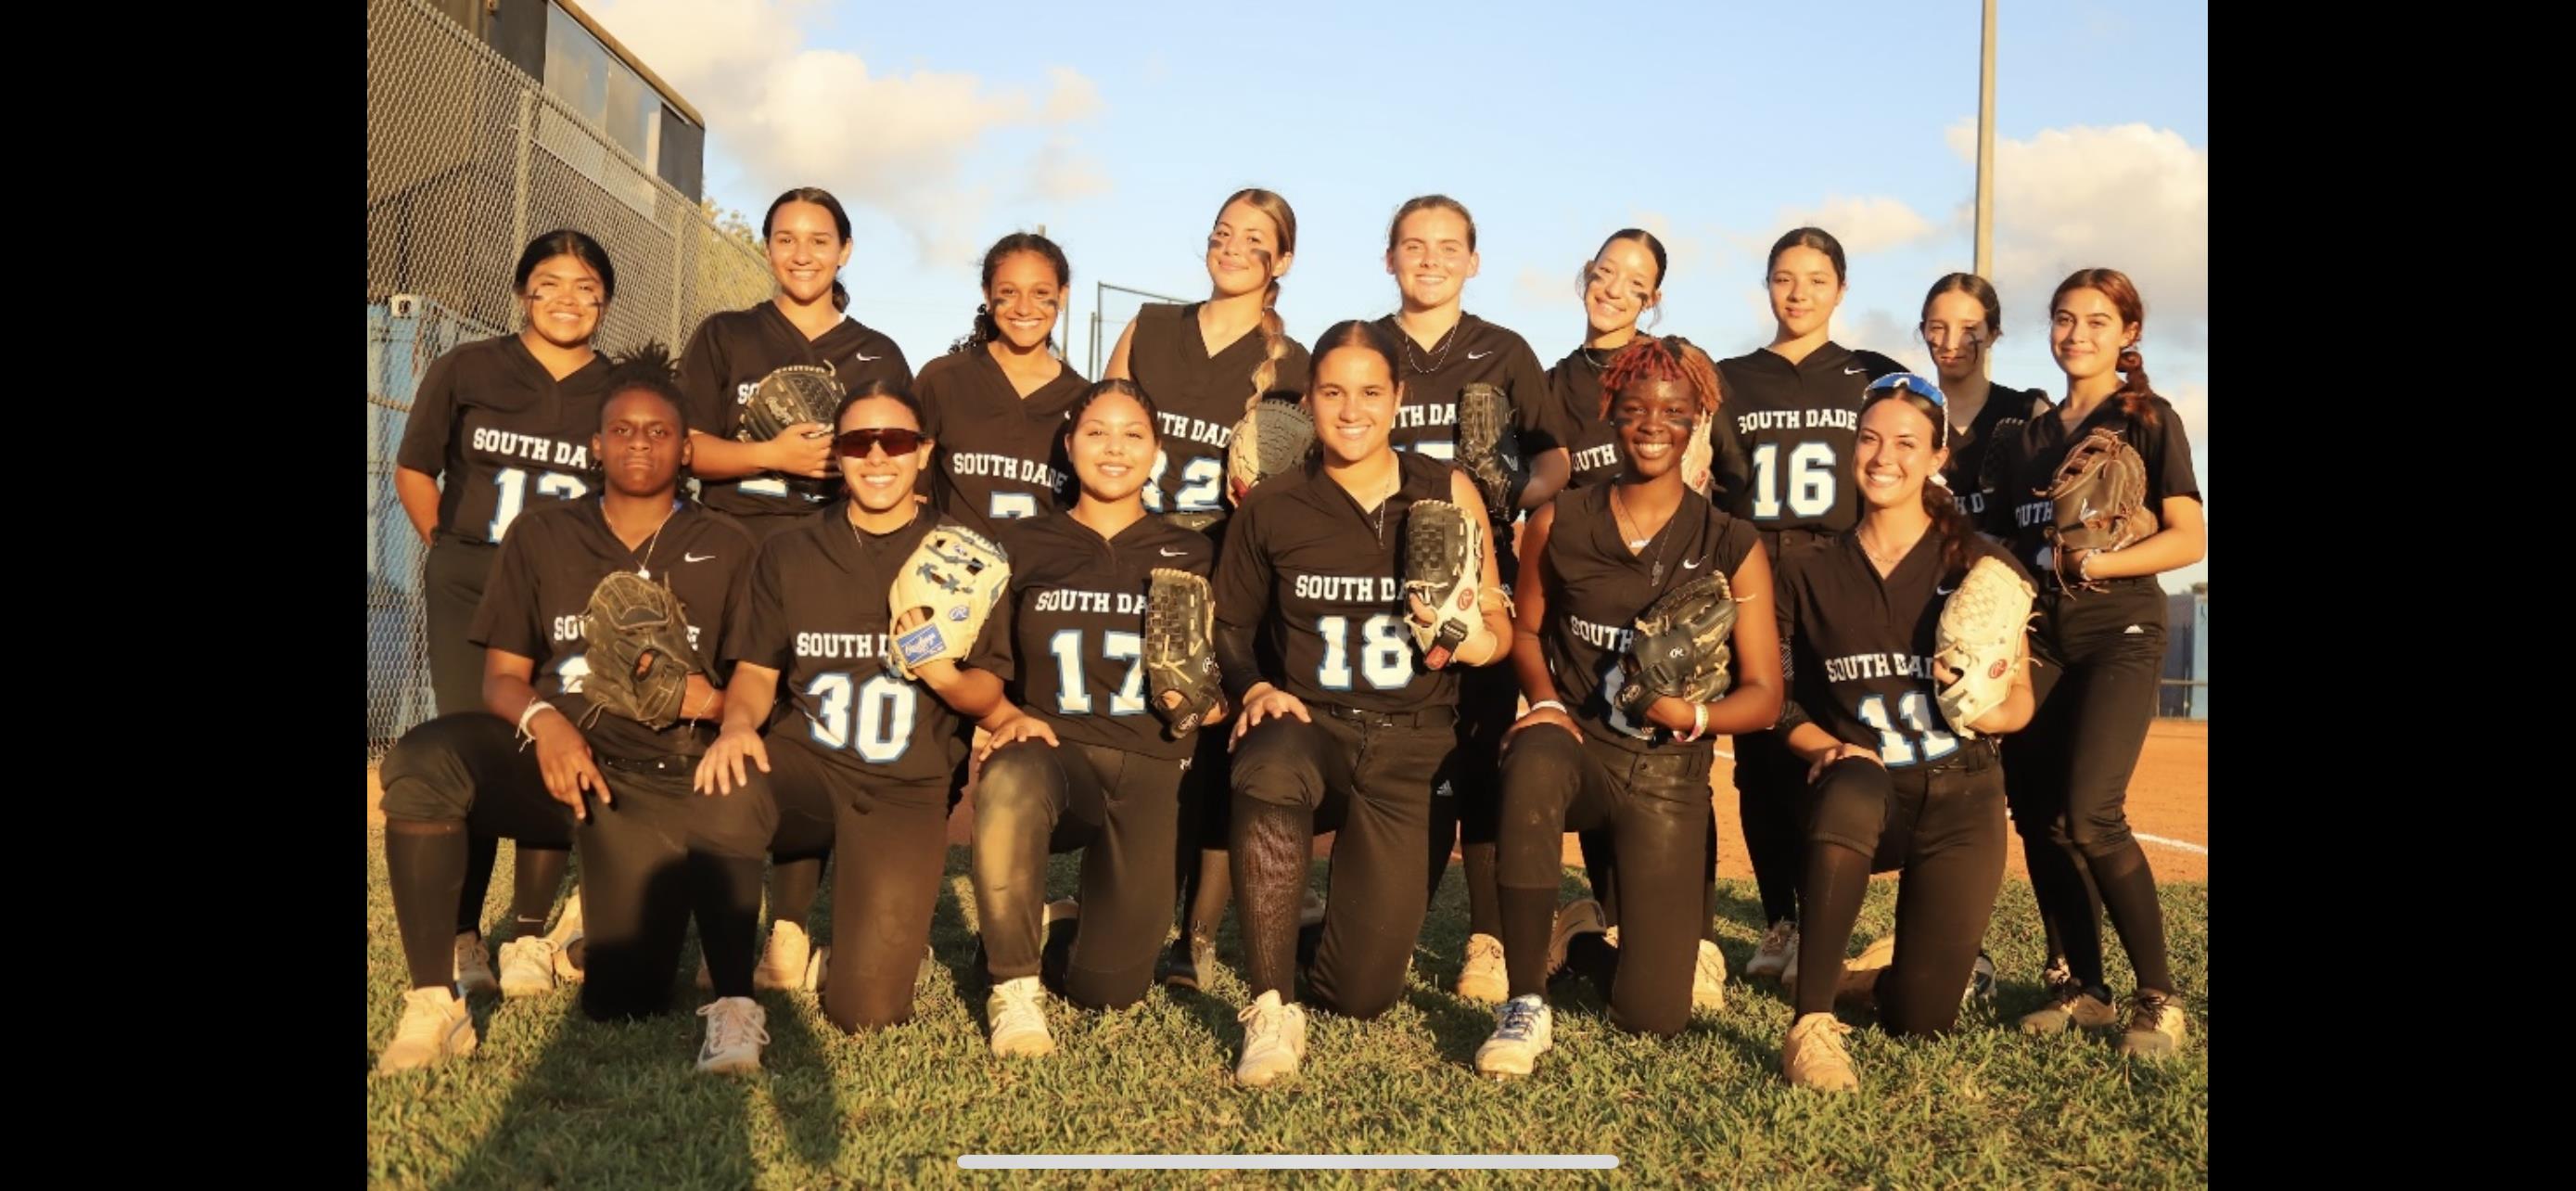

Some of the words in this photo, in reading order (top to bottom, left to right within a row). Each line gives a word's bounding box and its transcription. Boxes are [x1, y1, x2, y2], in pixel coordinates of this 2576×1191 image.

[1429, 403, 1458, 426] DA
[1738, 410, 1800, 434] SOUTH
[1805, 408, 1857, 431] DADE
[473, 428, 551, 461] SOUTH
[554, 442, 588, 469] DA
[1191, 419, 1231, 448] DAD
[952, 453, 1018, 480] SOUTH
[1752, 441, 1837, 519] 16
[1034, 588, 1110, 613] SOUTH
[1116, 593, 1147, 614] DA
[1295, 574, 1373, 602] SOUTH
[797, 632, 873, 659] SOUTH
[1571, 615, 1634, 653] SOUTH
[1317, 612, 1415, 691] 18
[1049, 629, 1146, 715] 17
[1825, 653, 1892, 683] SOUTH
[1893, 653, 1934, 680] DA
[805, 672, 917, 762] 30
[1858, 691, 1958, 767] 11
